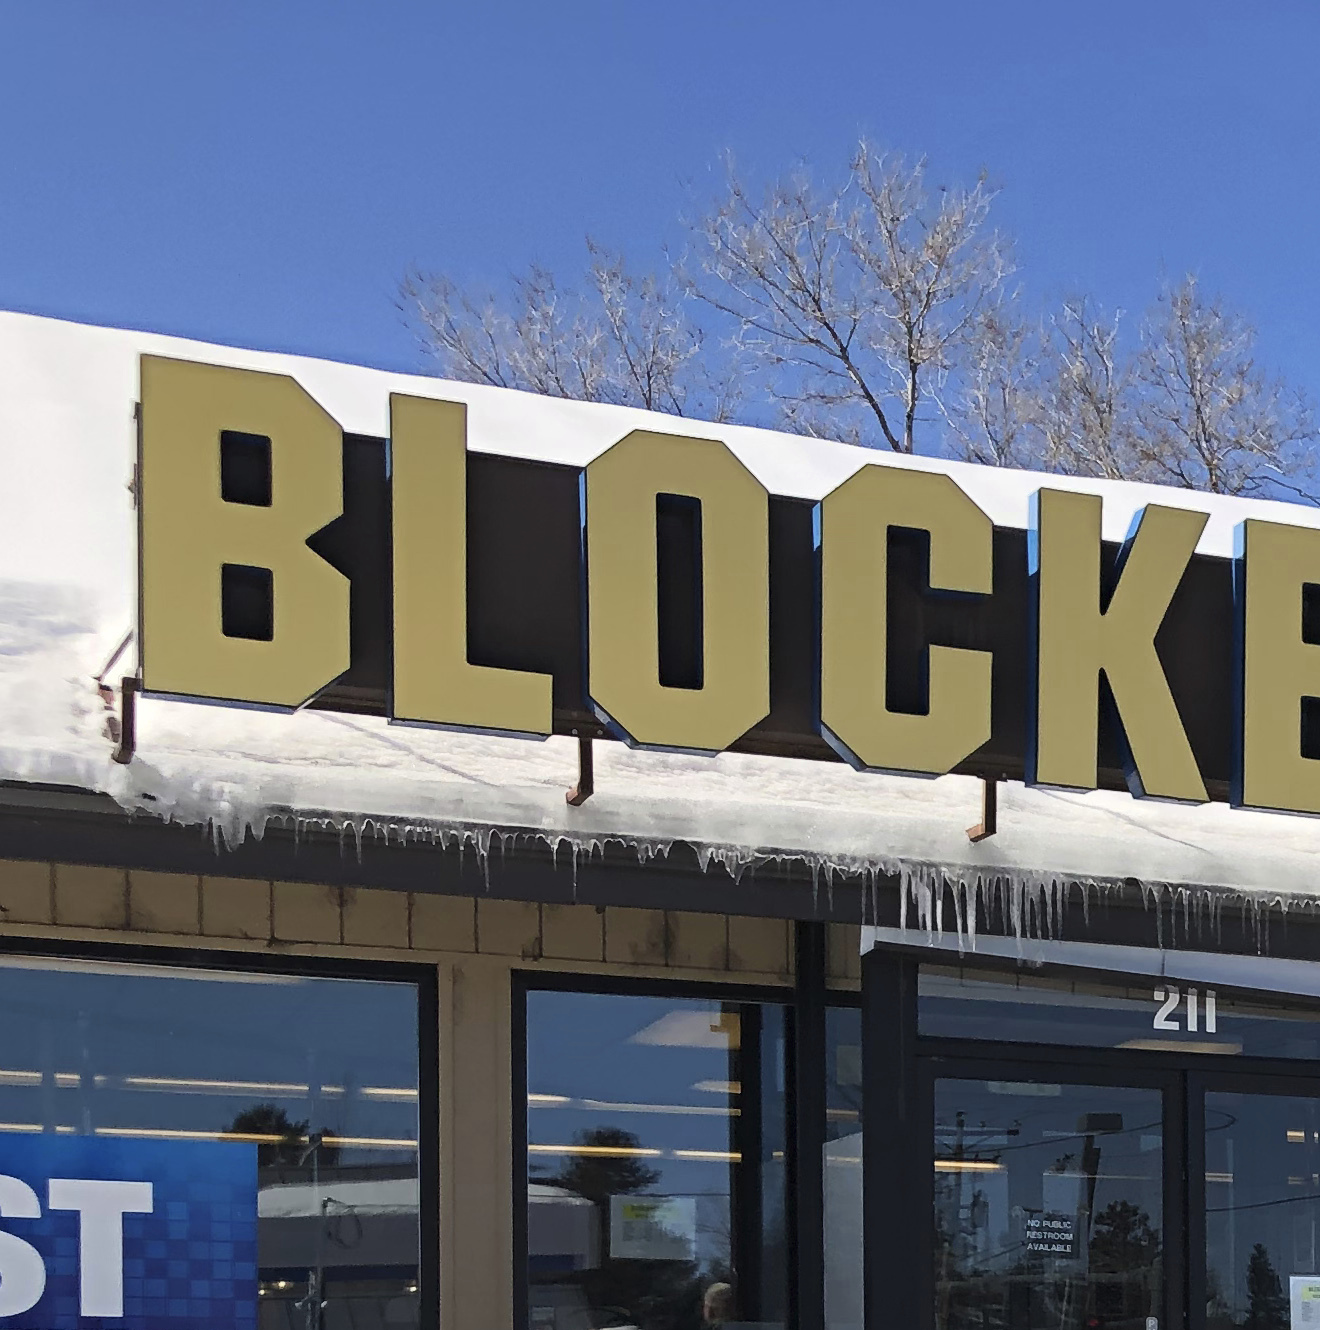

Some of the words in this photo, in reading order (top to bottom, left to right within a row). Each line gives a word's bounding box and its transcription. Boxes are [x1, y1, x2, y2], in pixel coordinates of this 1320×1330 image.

[1153, 984, 1217, 1034] 211
[1027, 1219, 1040, 1227] NO
[1042, 1220, 1072, 1229] PUBLIC
[1026, 1231, 1073, 1240] RESTROOM
[1026, 1243, 1071, 1252] AVAILABLE
